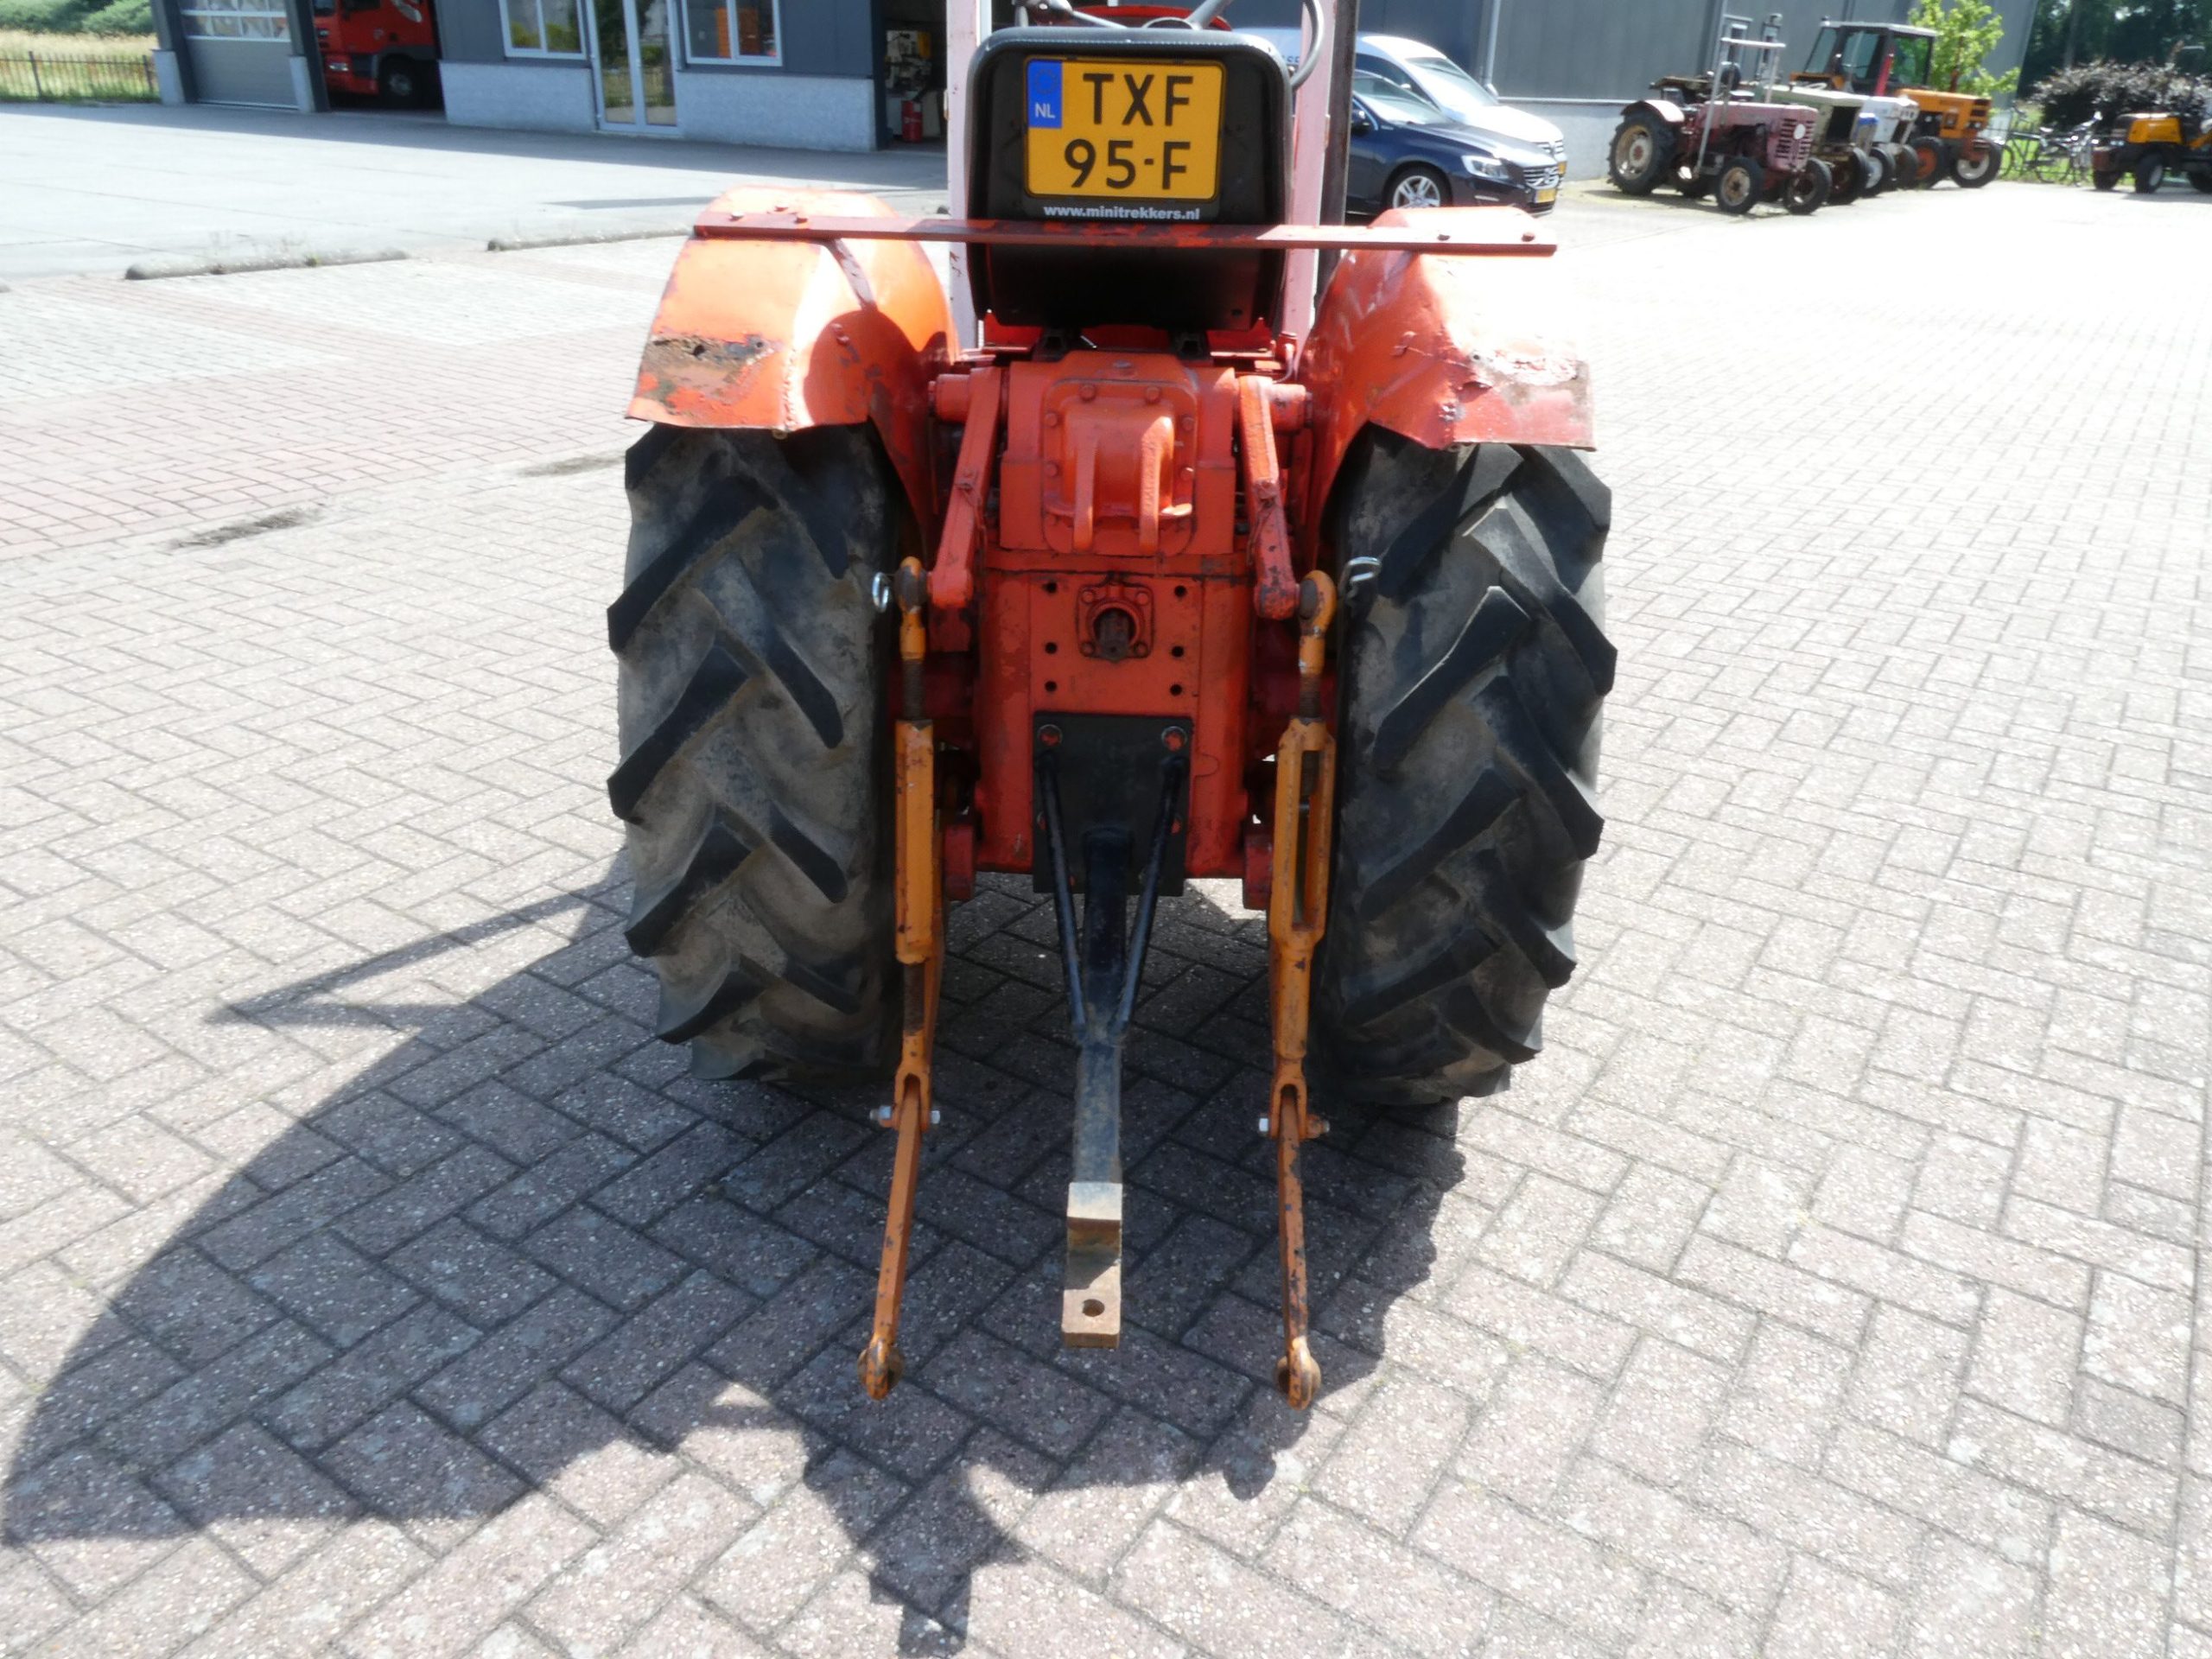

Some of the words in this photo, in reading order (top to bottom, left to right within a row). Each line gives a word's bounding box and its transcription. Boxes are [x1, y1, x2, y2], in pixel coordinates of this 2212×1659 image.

[1034, 103, 1056, 118] NL
[1083, 73, 1194, 126] TXF
[1064, 138, 1191, 190] 95-F
[1043, 206, 1200, 220] www.minitrekkers.nl
